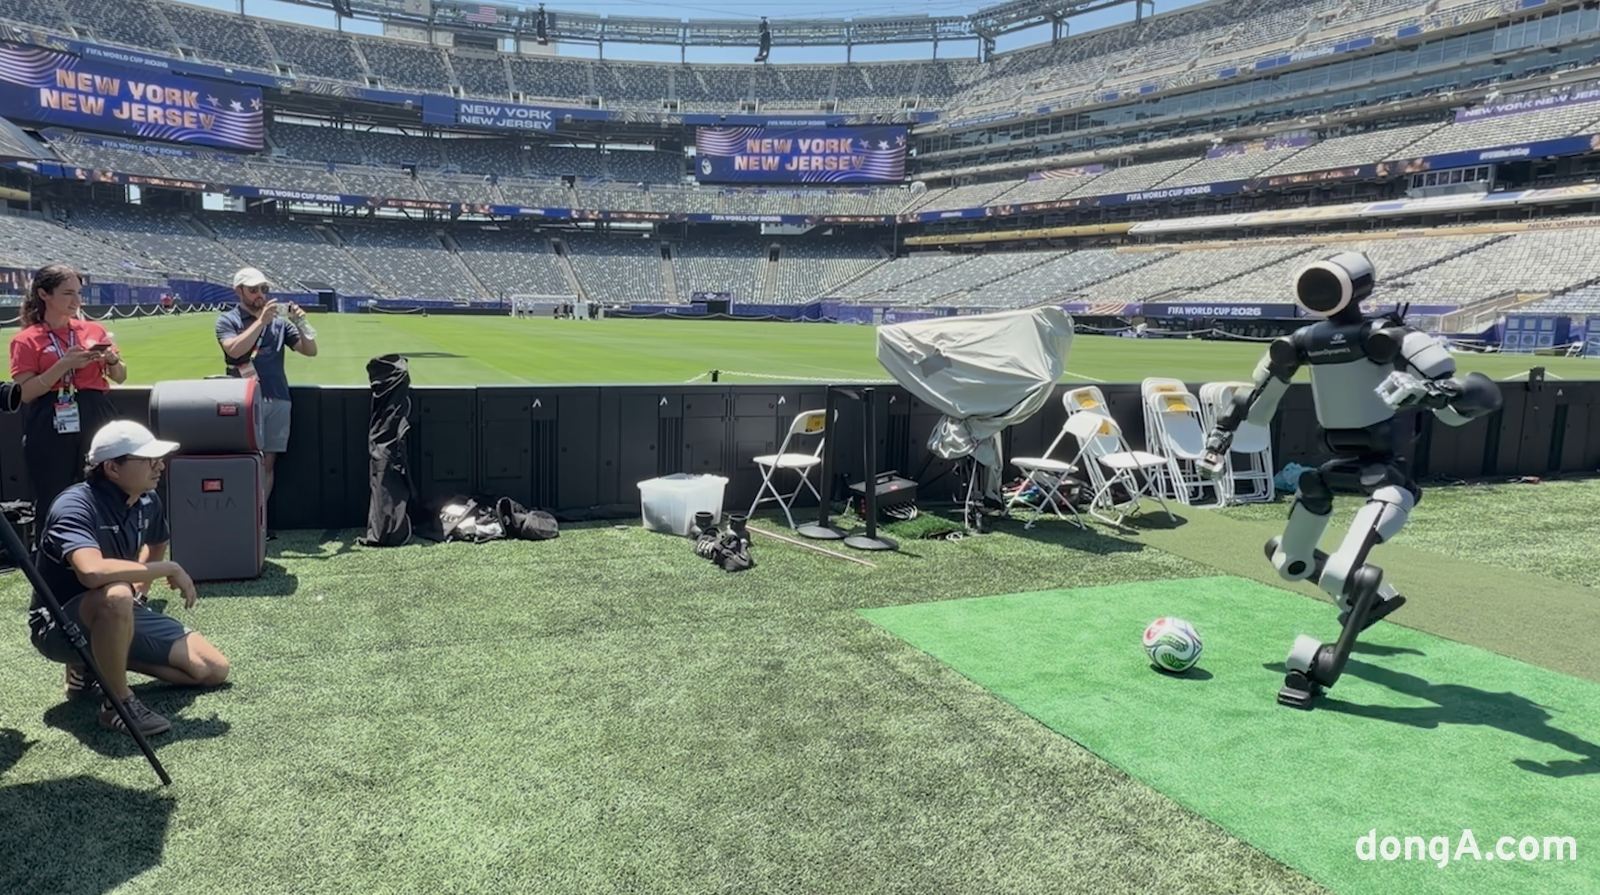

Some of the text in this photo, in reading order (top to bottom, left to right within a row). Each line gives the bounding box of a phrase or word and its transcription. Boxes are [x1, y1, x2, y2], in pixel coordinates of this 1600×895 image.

[86, 47, 169, 68] FIFA WORLD CUP 2026
[56, 68, 200, 108] NEW YORK
[40, 88, 216, 130] NEW JERSEY
[460, 103, 552, 120] NEW YORK
[1464, 106, 1494, 117] NEW
[1494, 100, 1533, 112] YORK
[1534, 94, 1568, 106] NEW
[460, 114, 552, 130] NEW JERSEY
[102, 141, 118, 149] FIFA
[118, 143, 144, 152] WORLD
[144, 146, 159, 154] CUP
[746, 138, 854, 154] NEW YORK
[734, 155, 865, 171] NEW JERSEY
[258, 188, 275, 197] FIFA
[275, 190, 300, 199] WORLD
[301, 192, 316, 200] CUP
[1126, 185, 1212, 201] FIFA WORLD CUP 2026
[1167, 306, 1262, 316] FIFA WORLD CUP 2026
